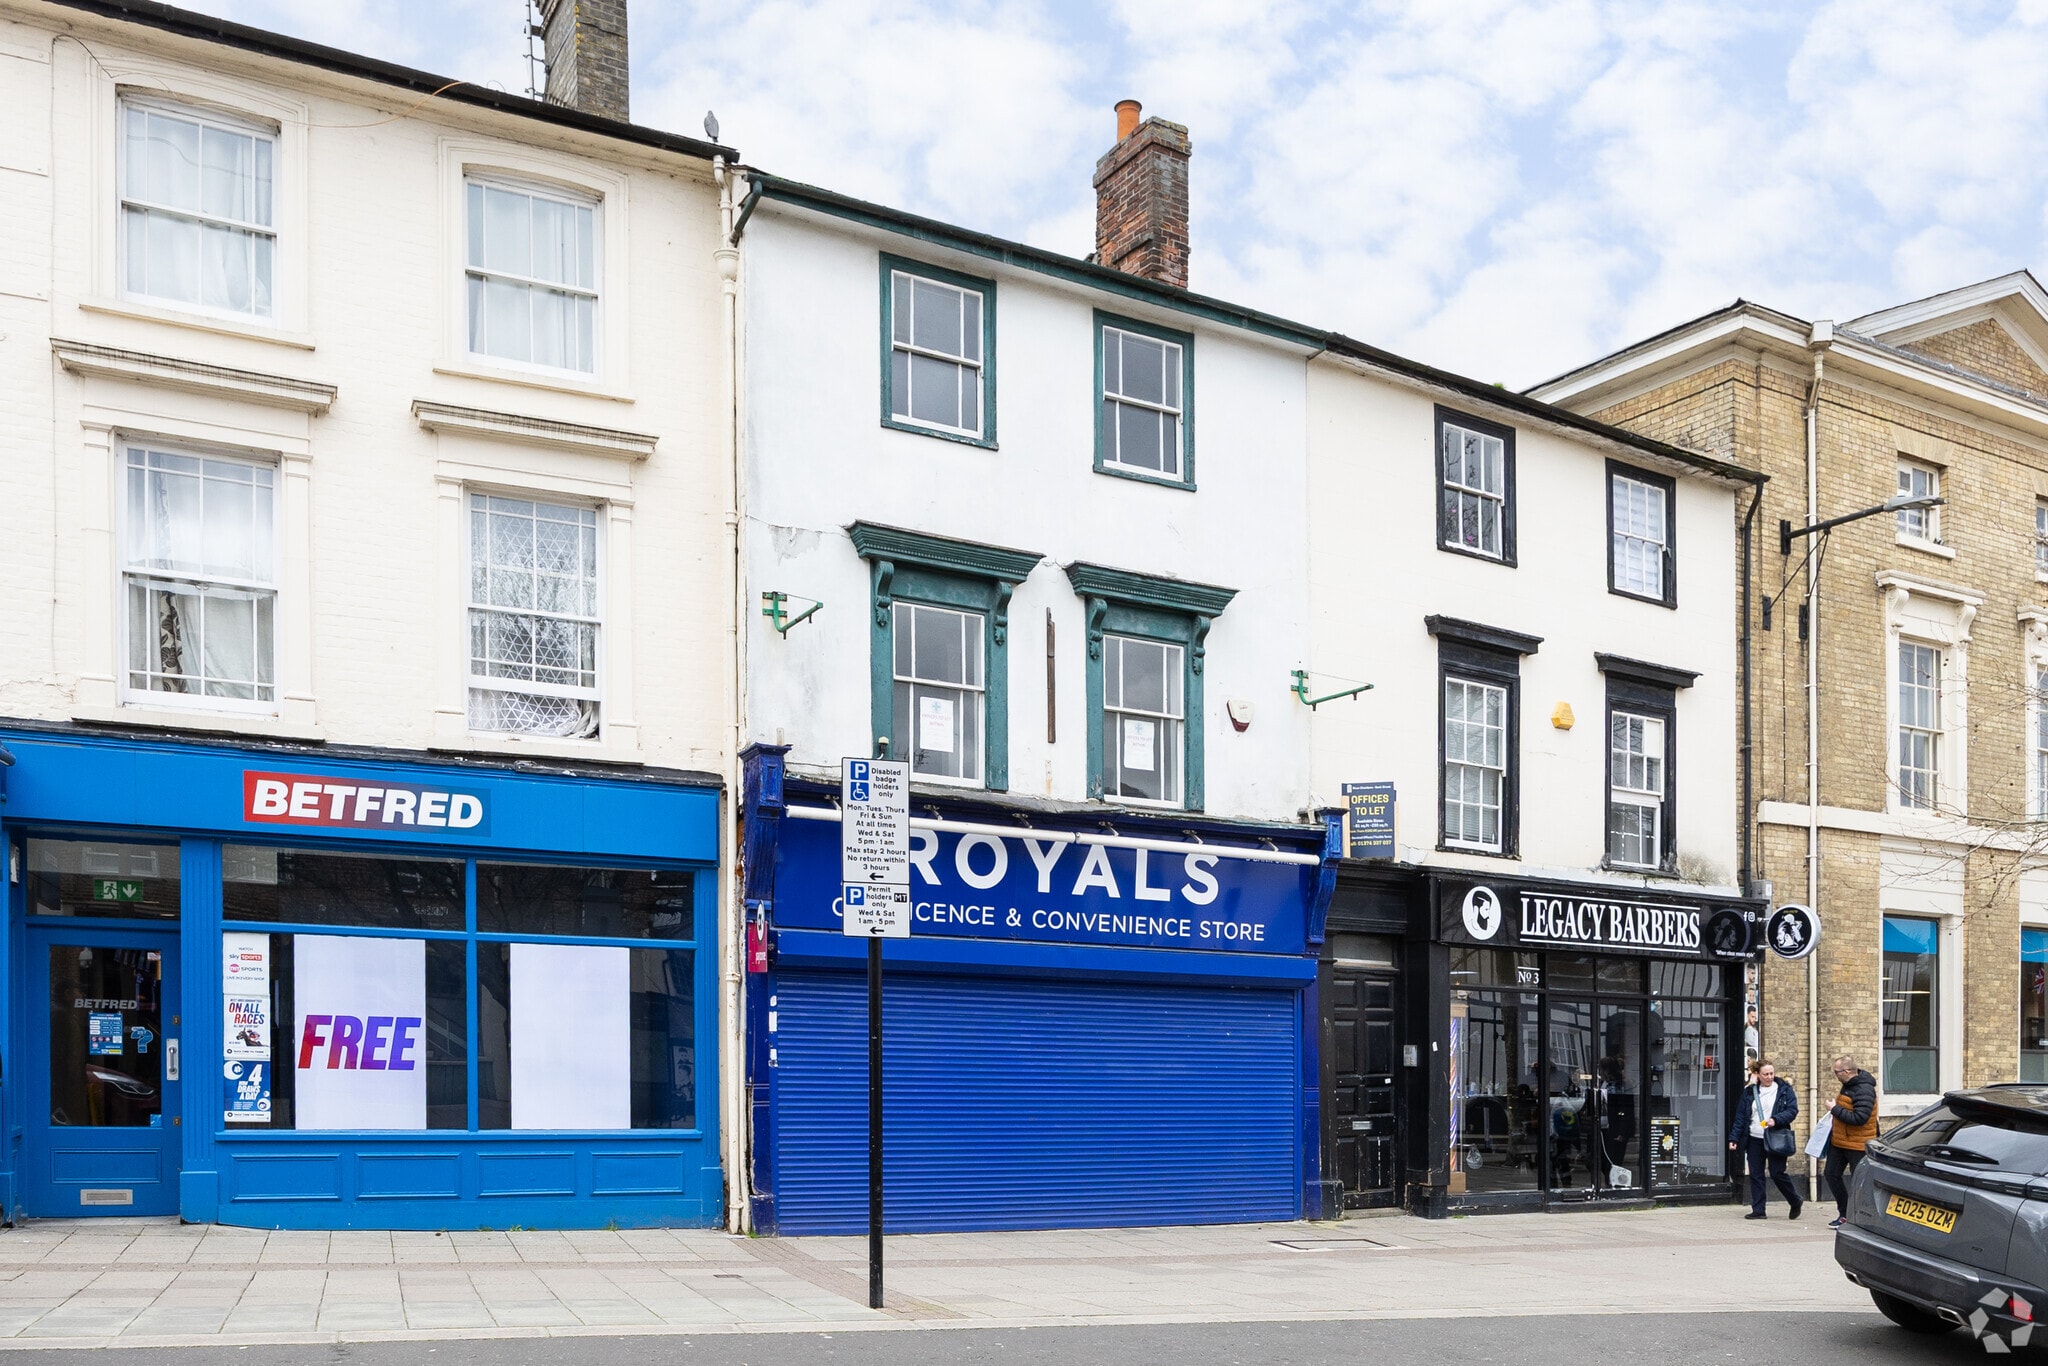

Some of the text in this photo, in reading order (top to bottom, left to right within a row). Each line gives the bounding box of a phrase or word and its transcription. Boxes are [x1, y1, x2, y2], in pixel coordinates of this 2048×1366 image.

[854, 763, 867, 779] P
[871, 767, 902, 776] Disabled
[875, 775, 897, 783] badge
[252, 779, 483, 828] BETFRED
[1351, 794, 1389, 804] OFFICES
[885, 805, 905, 813] Thurs
[1355, 806, 1385, 816] TO LET
[886, 848, 906, 856] hours
[909, 828, 1219, 906] ROYALS
[849, 888, 862, 904] P
[895, 893, 907, 903] MT
[909, 902, 1265, 942] ICENCE & CONVENIENCE STORE
[1520, 897, 1701, 948] LEGACY BARBERS
[1533, 972, 1540, 985] 3
[74, 998, 138, 1010] BETFRED
[229, 1002, 261, 1013] ON ALL
[234, 1013, 265, 1024] RACES
[298, 1014, 422, 1070] FREE
[248, 1064, 263, 1086] 4
[1894, 1198, 1954, 1229] EO25 OZM
